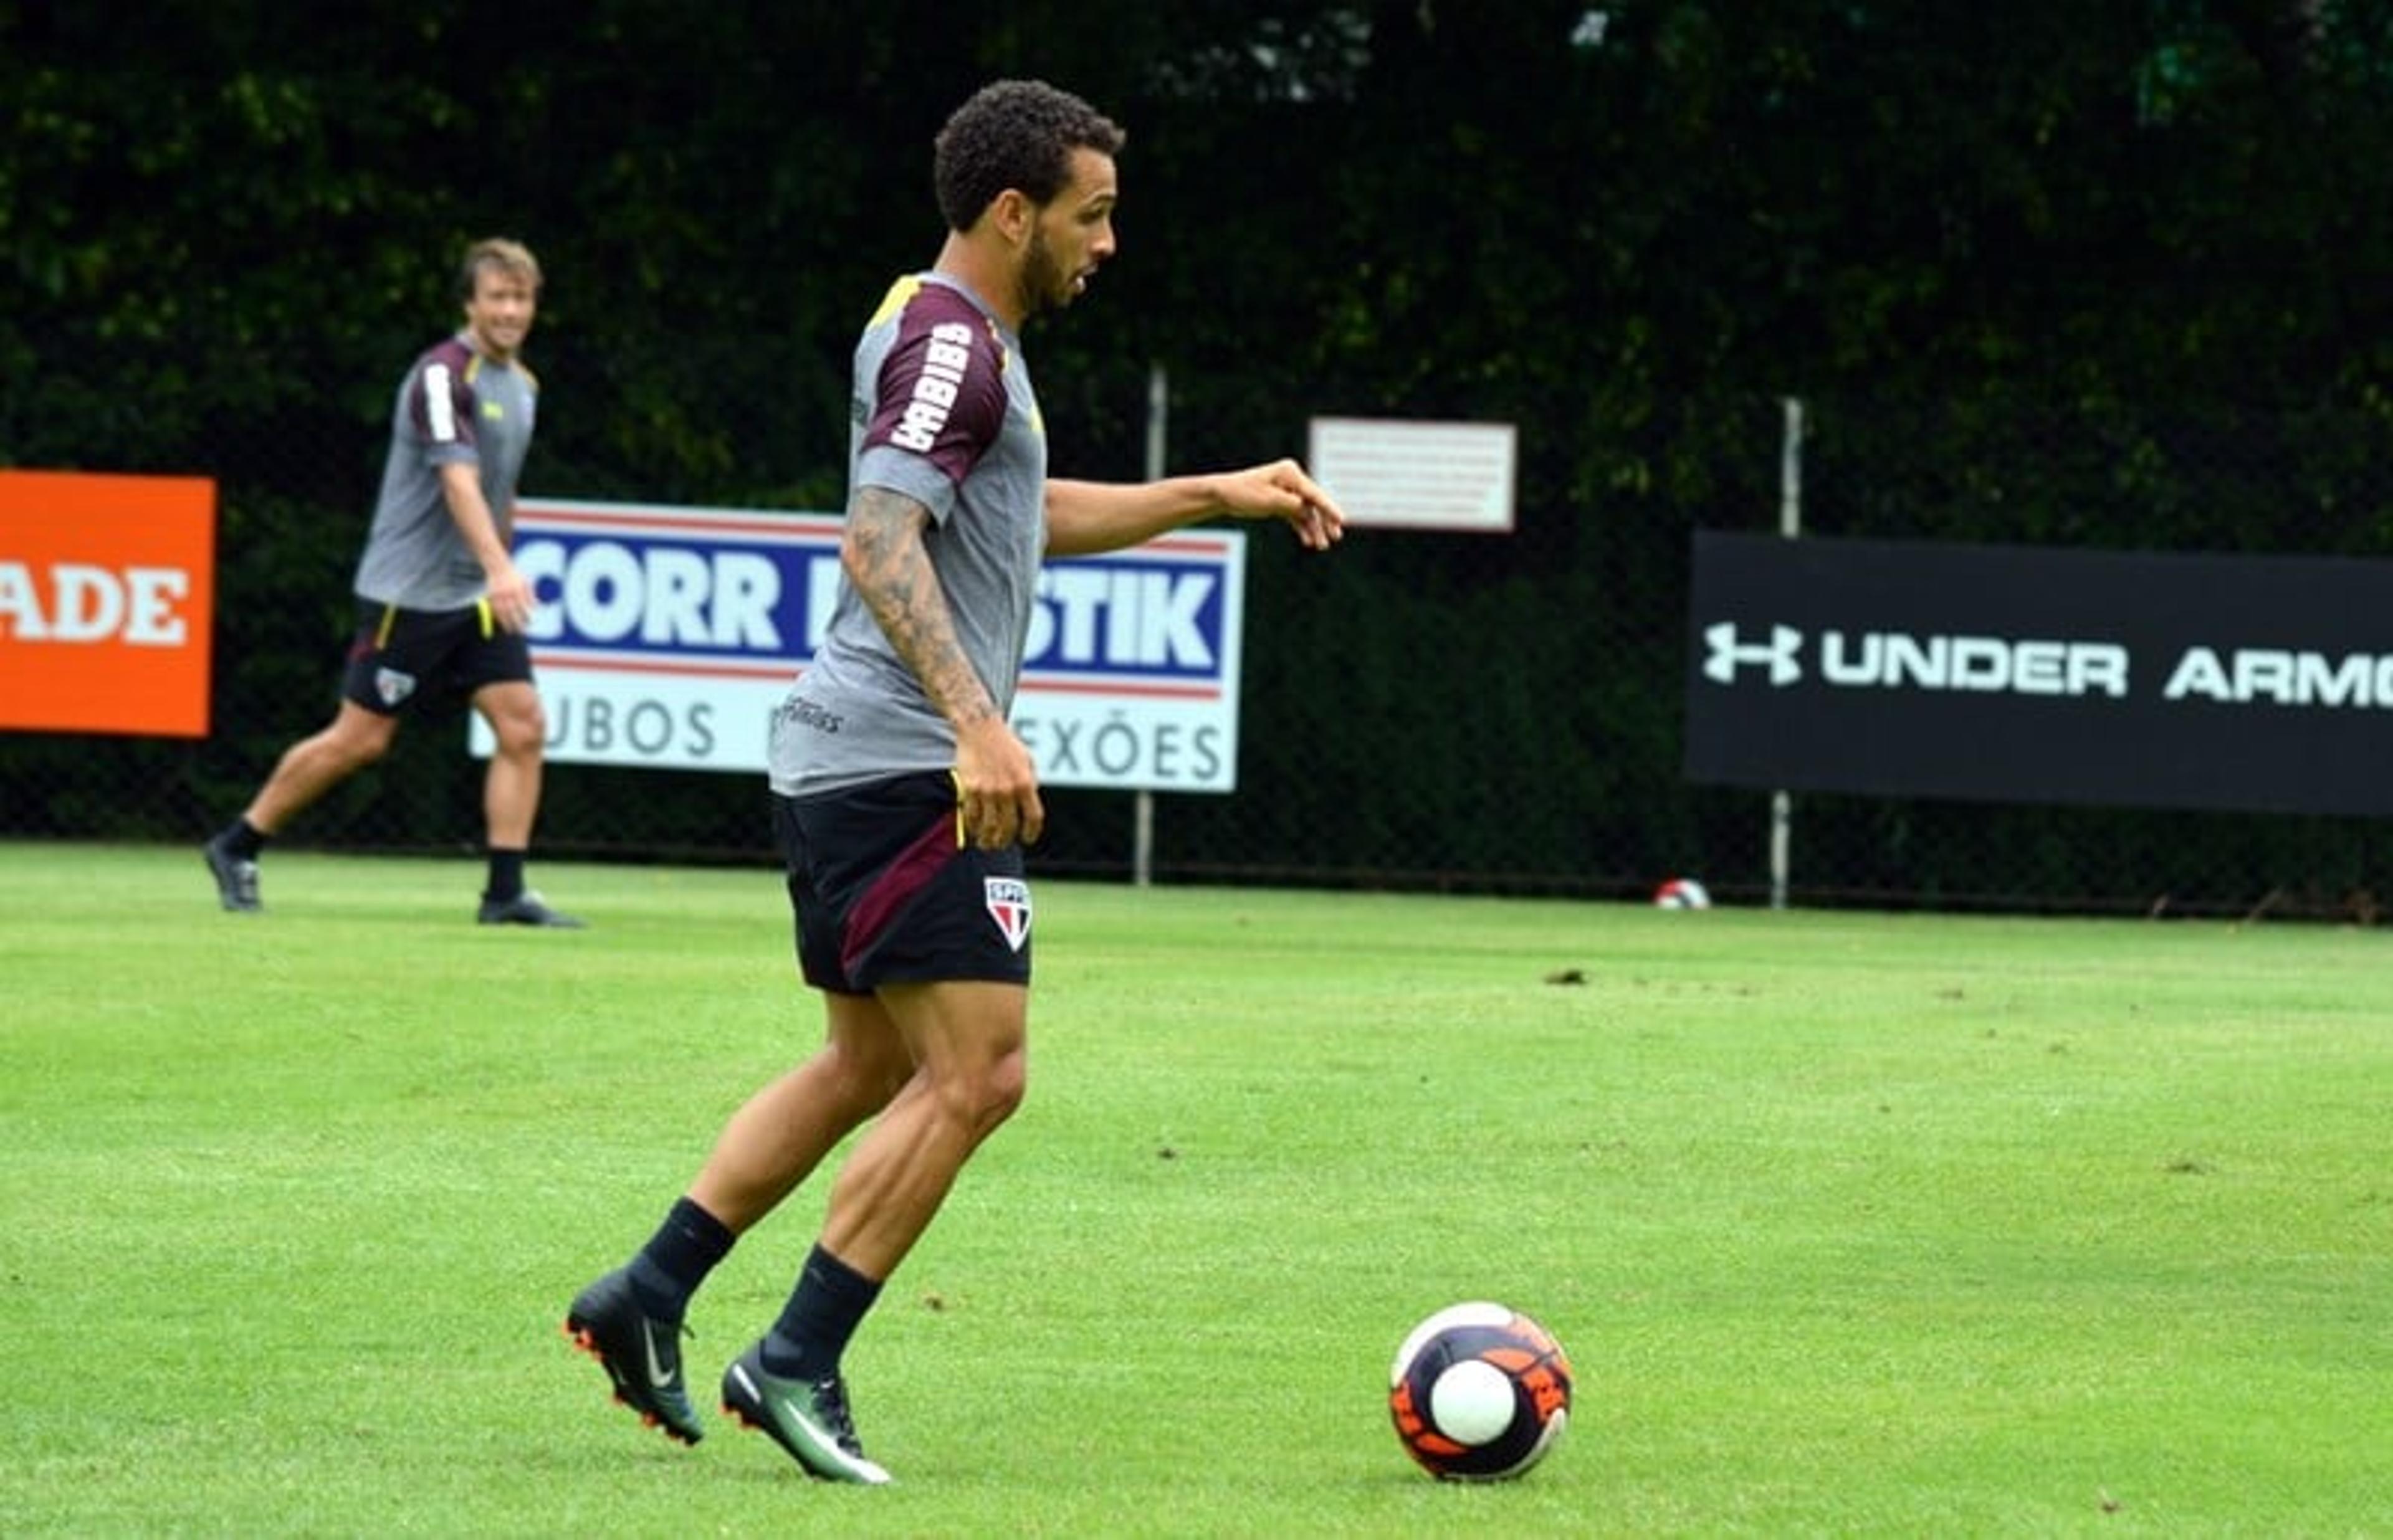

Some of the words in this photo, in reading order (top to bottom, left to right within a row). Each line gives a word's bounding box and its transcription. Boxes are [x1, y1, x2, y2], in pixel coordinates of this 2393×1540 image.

[513, 539, 783, 649] CORR
[1822, 632, 2129, 696] UNDER
[2162, 647, 2393, 708] ARM
